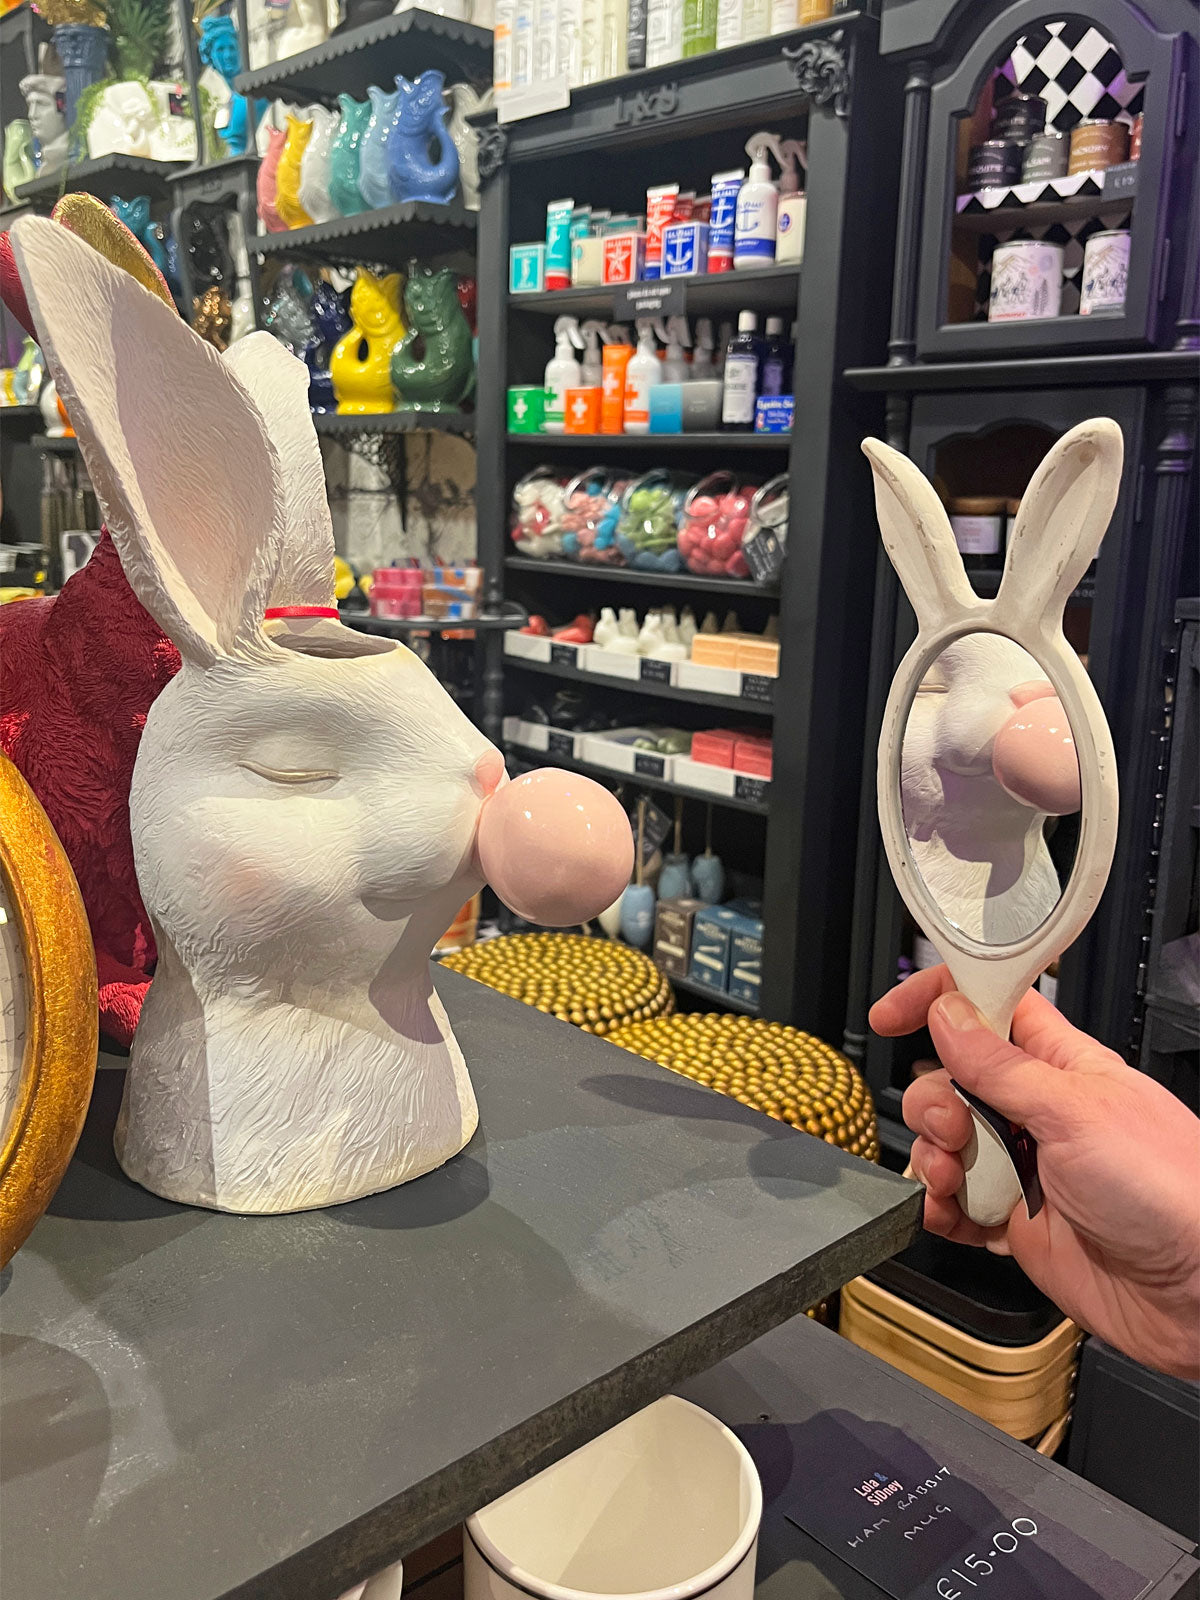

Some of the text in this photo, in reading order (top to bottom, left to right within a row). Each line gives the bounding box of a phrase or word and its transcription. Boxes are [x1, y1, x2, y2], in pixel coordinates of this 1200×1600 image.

[848, 1466, 951, 1548] HAM RABBIT
[853, 1472, 889, 1497] Lola &
[904, 1504, 952, 1541] MUG
[936, 1517, 1038, 1600] £15.00
